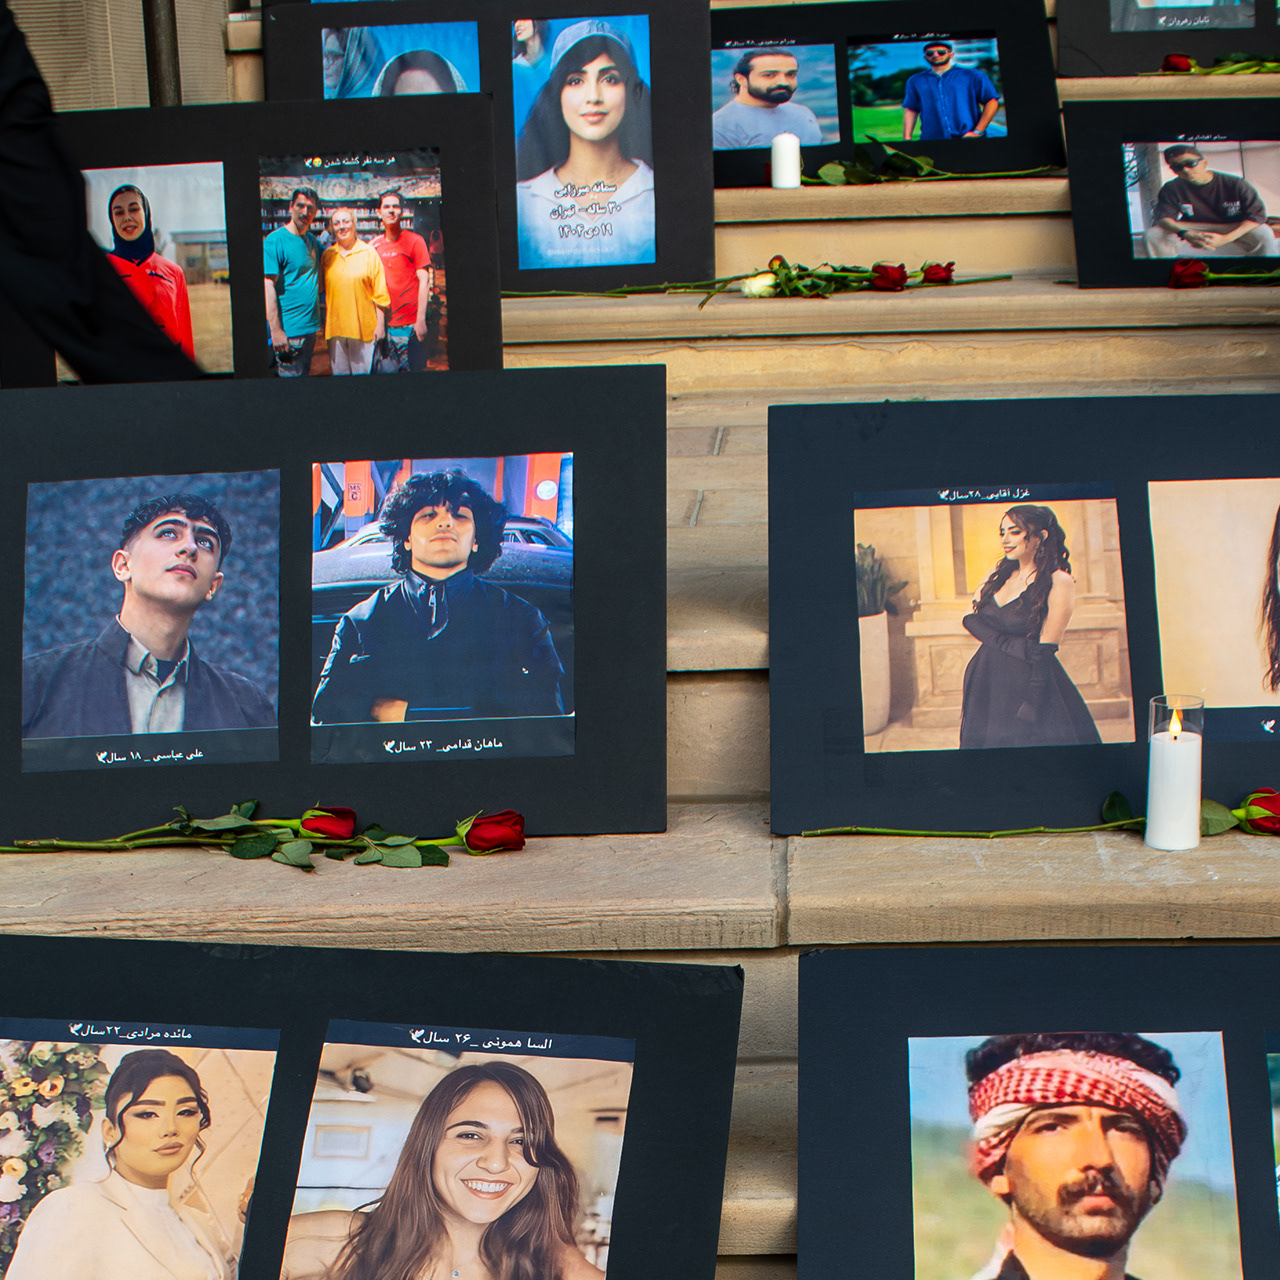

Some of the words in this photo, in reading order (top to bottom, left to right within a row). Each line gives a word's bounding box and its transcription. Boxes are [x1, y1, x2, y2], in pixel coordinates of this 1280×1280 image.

[591, 181, 617, 193] سمانه
[1012, 487, 1031, 500] غزل
[394, 741, 417, 754] سال
[473, 737, 504, 752] ماهان
[106, 752, 127, 764] سال
[152, 749, 184, 762] عباسی
[186, 748, 204, 761] علی
[422, 1031, 450, 1045] سال
[481, 1036, 522, 1050] همونی
[526, 1036, 553, 1050] السا
